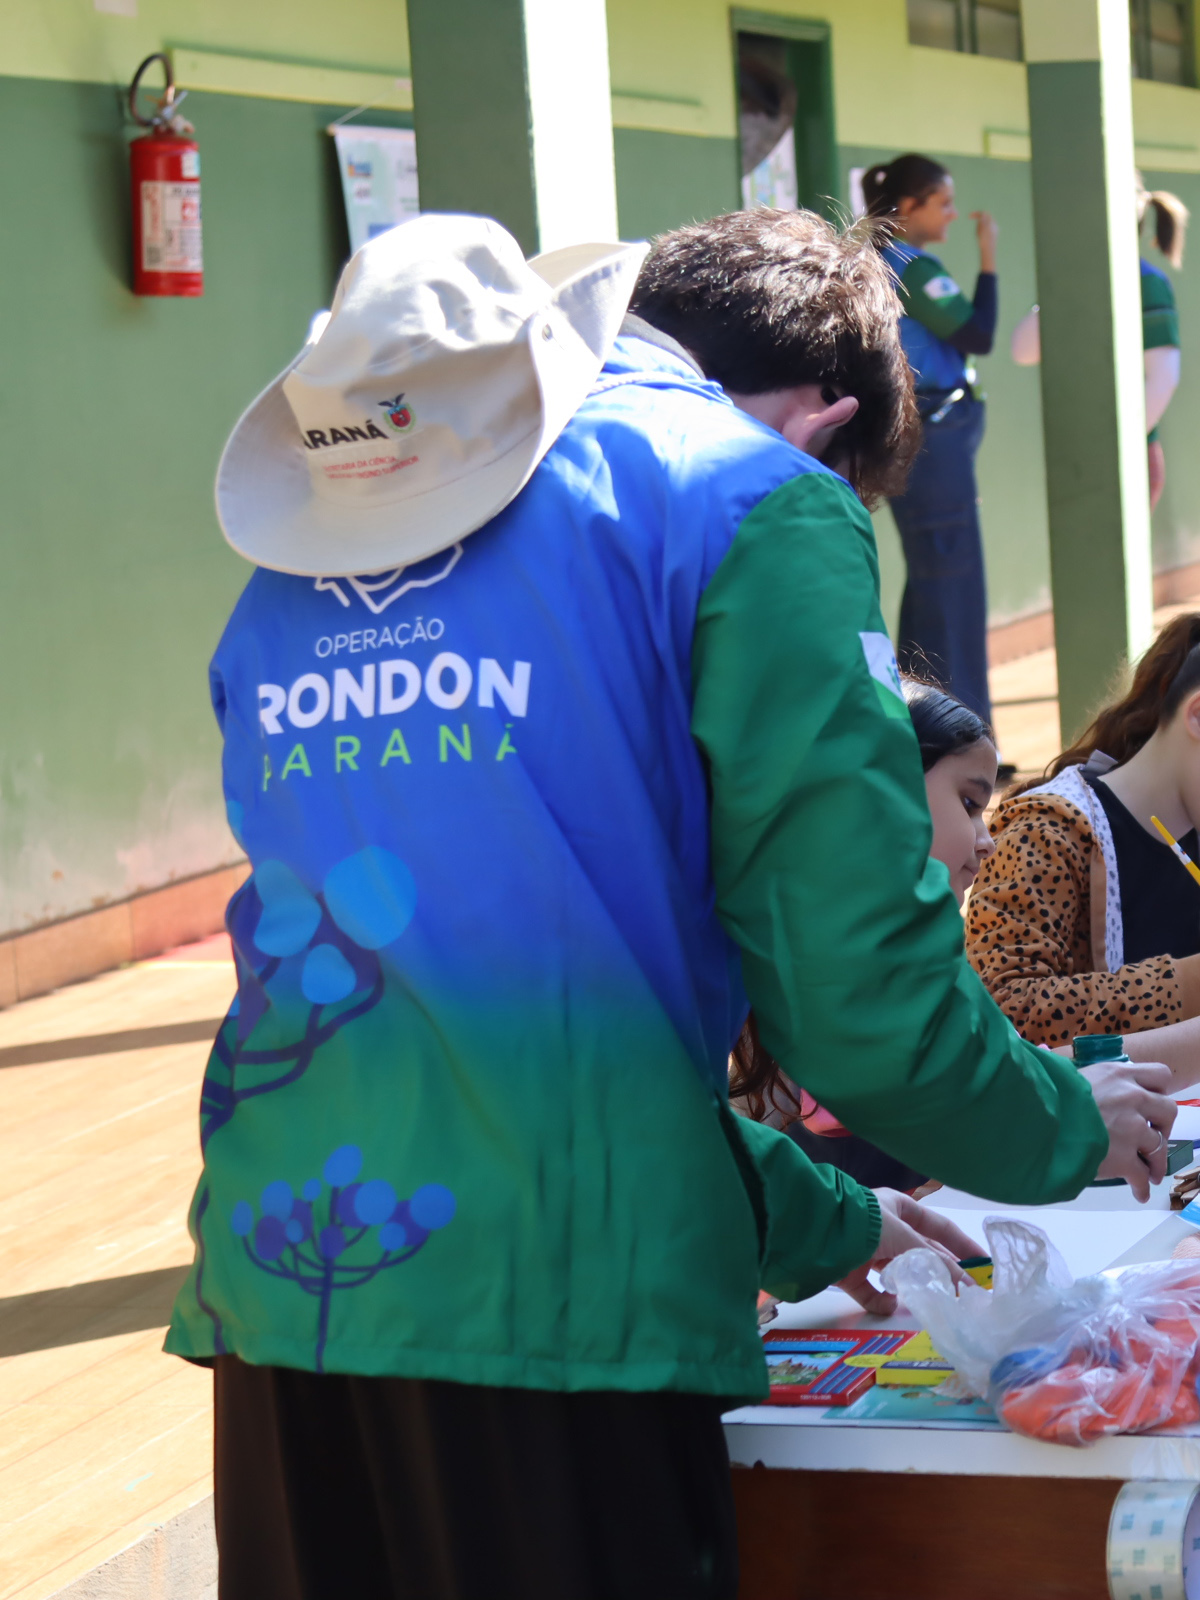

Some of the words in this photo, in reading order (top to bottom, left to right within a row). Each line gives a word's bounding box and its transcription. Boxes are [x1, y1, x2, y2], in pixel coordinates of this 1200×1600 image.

[304, 419, 389, 449] RANÁ
[315, 616, 445, 658] OPERAÇÃO
[257, 651, 532, 735] RONDON
